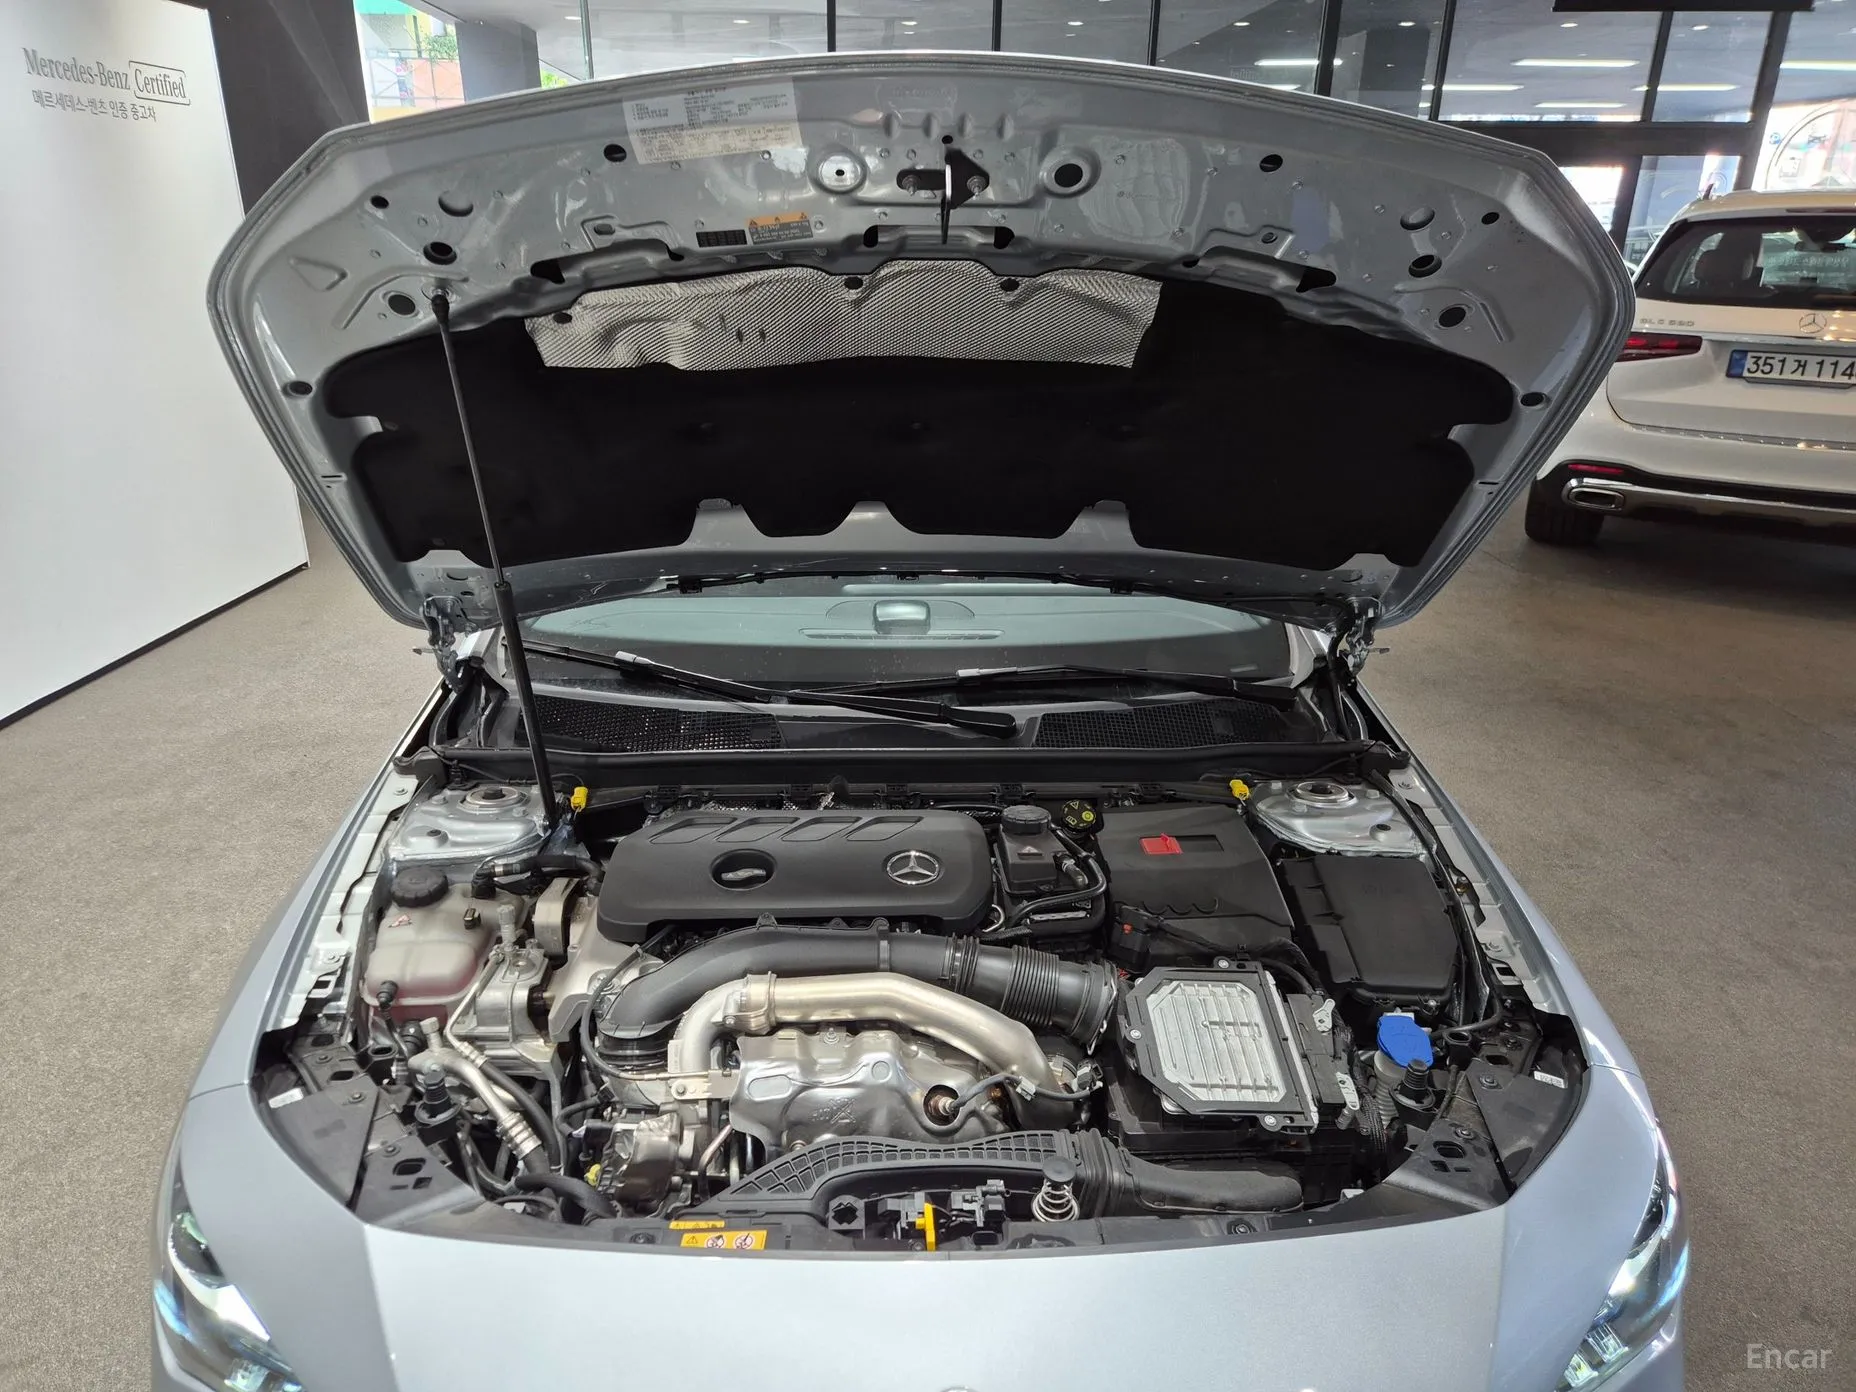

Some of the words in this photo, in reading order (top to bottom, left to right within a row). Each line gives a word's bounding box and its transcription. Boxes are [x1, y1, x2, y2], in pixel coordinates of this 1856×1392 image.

[22, 47, 131, 90] Mercedes-Benz
[134, 68, 187, 99] Certified
[32, 89, 108, 115] 메르세데스-벤츠
[109, 100, 128, 120] 인증
[130, 103, 157, 122] 중고차
[1815, 358, 1856, 380] 114
